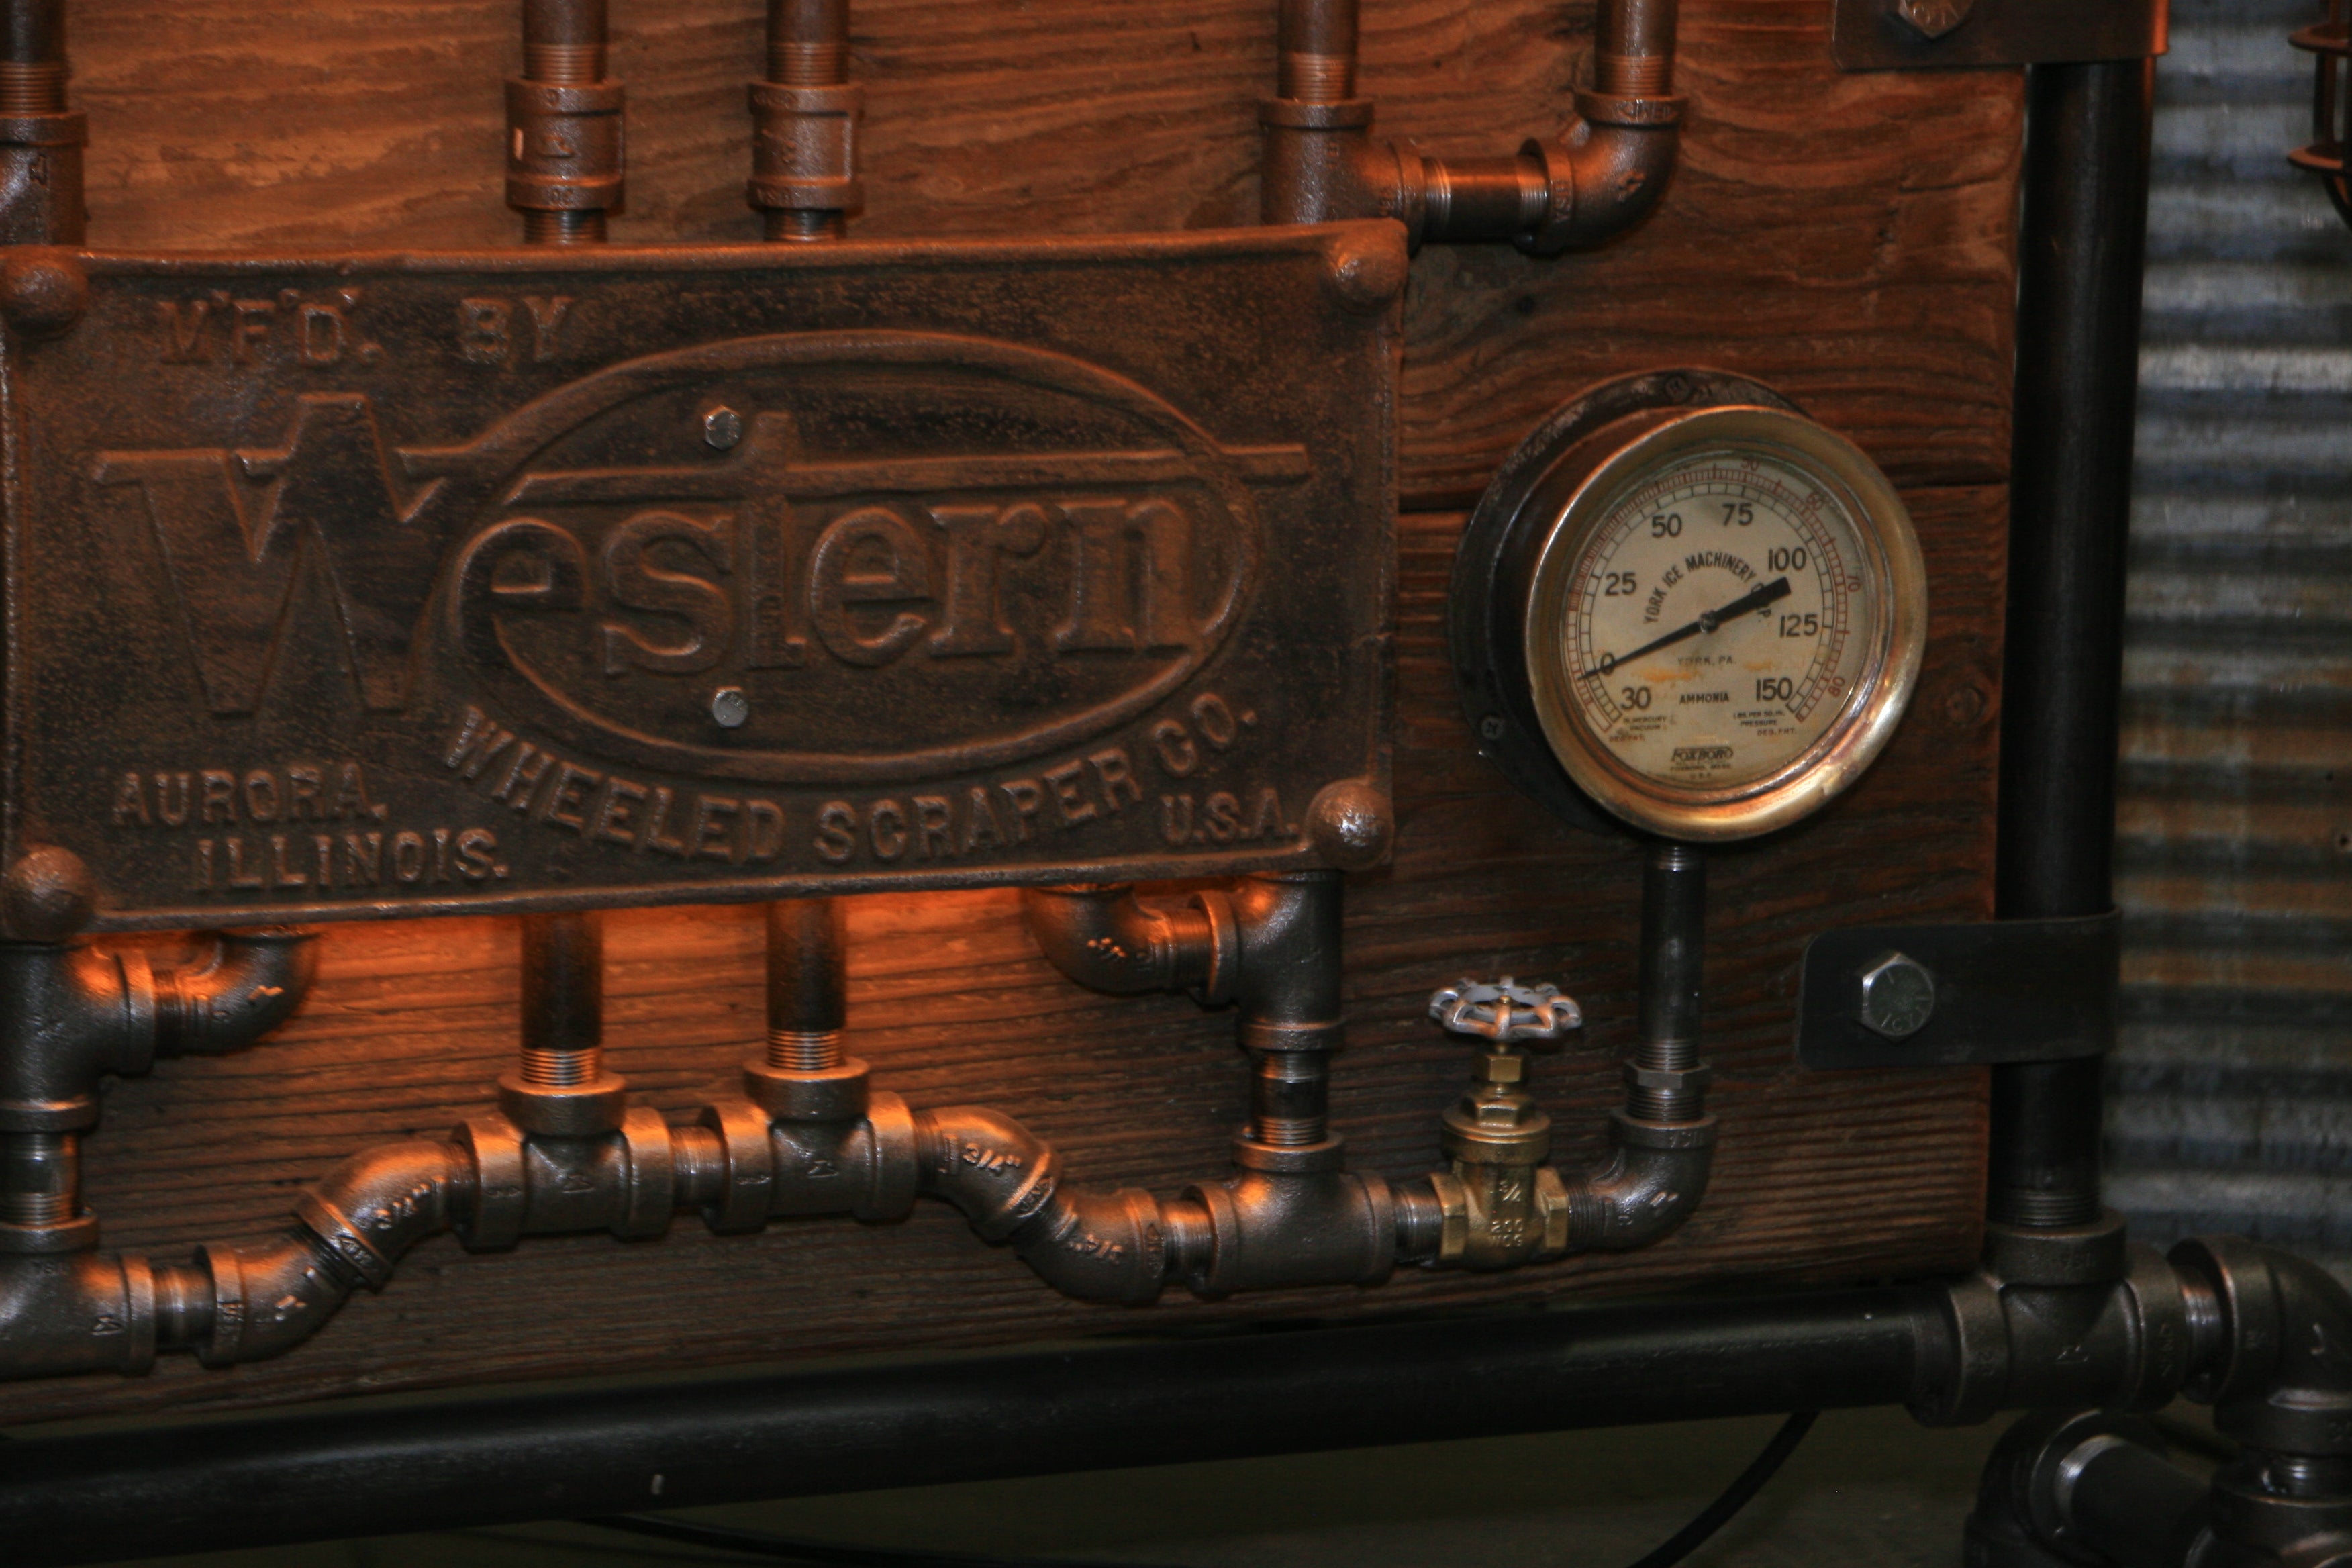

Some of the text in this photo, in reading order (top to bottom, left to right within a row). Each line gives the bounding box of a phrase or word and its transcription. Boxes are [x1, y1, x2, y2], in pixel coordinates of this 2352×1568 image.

[460, 295, 575, 366] BY
[1651, 513, 1683, 538] 50
[1722, 502, 1754, 526] 75
[93, 391, 1312, 720] Western
[1768, 547, 1807, 572] 100
[1605, 572, 1638, 597] 25
[1643, 587, 1667, 625] YORK
[1662, 564, 1684, 588] ICE
[1685, 550, 1757, 583] MACHINERY
[1847, 572, 1861, 592] 70
[1780, 614, 1818, 638] 125
[1600, 652, 1616, 675] 0
[1621, 686, 1651, 710] 30
[1679, 691, 1730, 705] AMMONIA
[1756, 677, 1794, 702] 150
[1828, 676, 1845, 697] 80
[444, 705, 785, 865] WHEELED
[812, 747, 1144, 865] SCRAPER
[195, 826, 510, 891] ILLINOIS.
